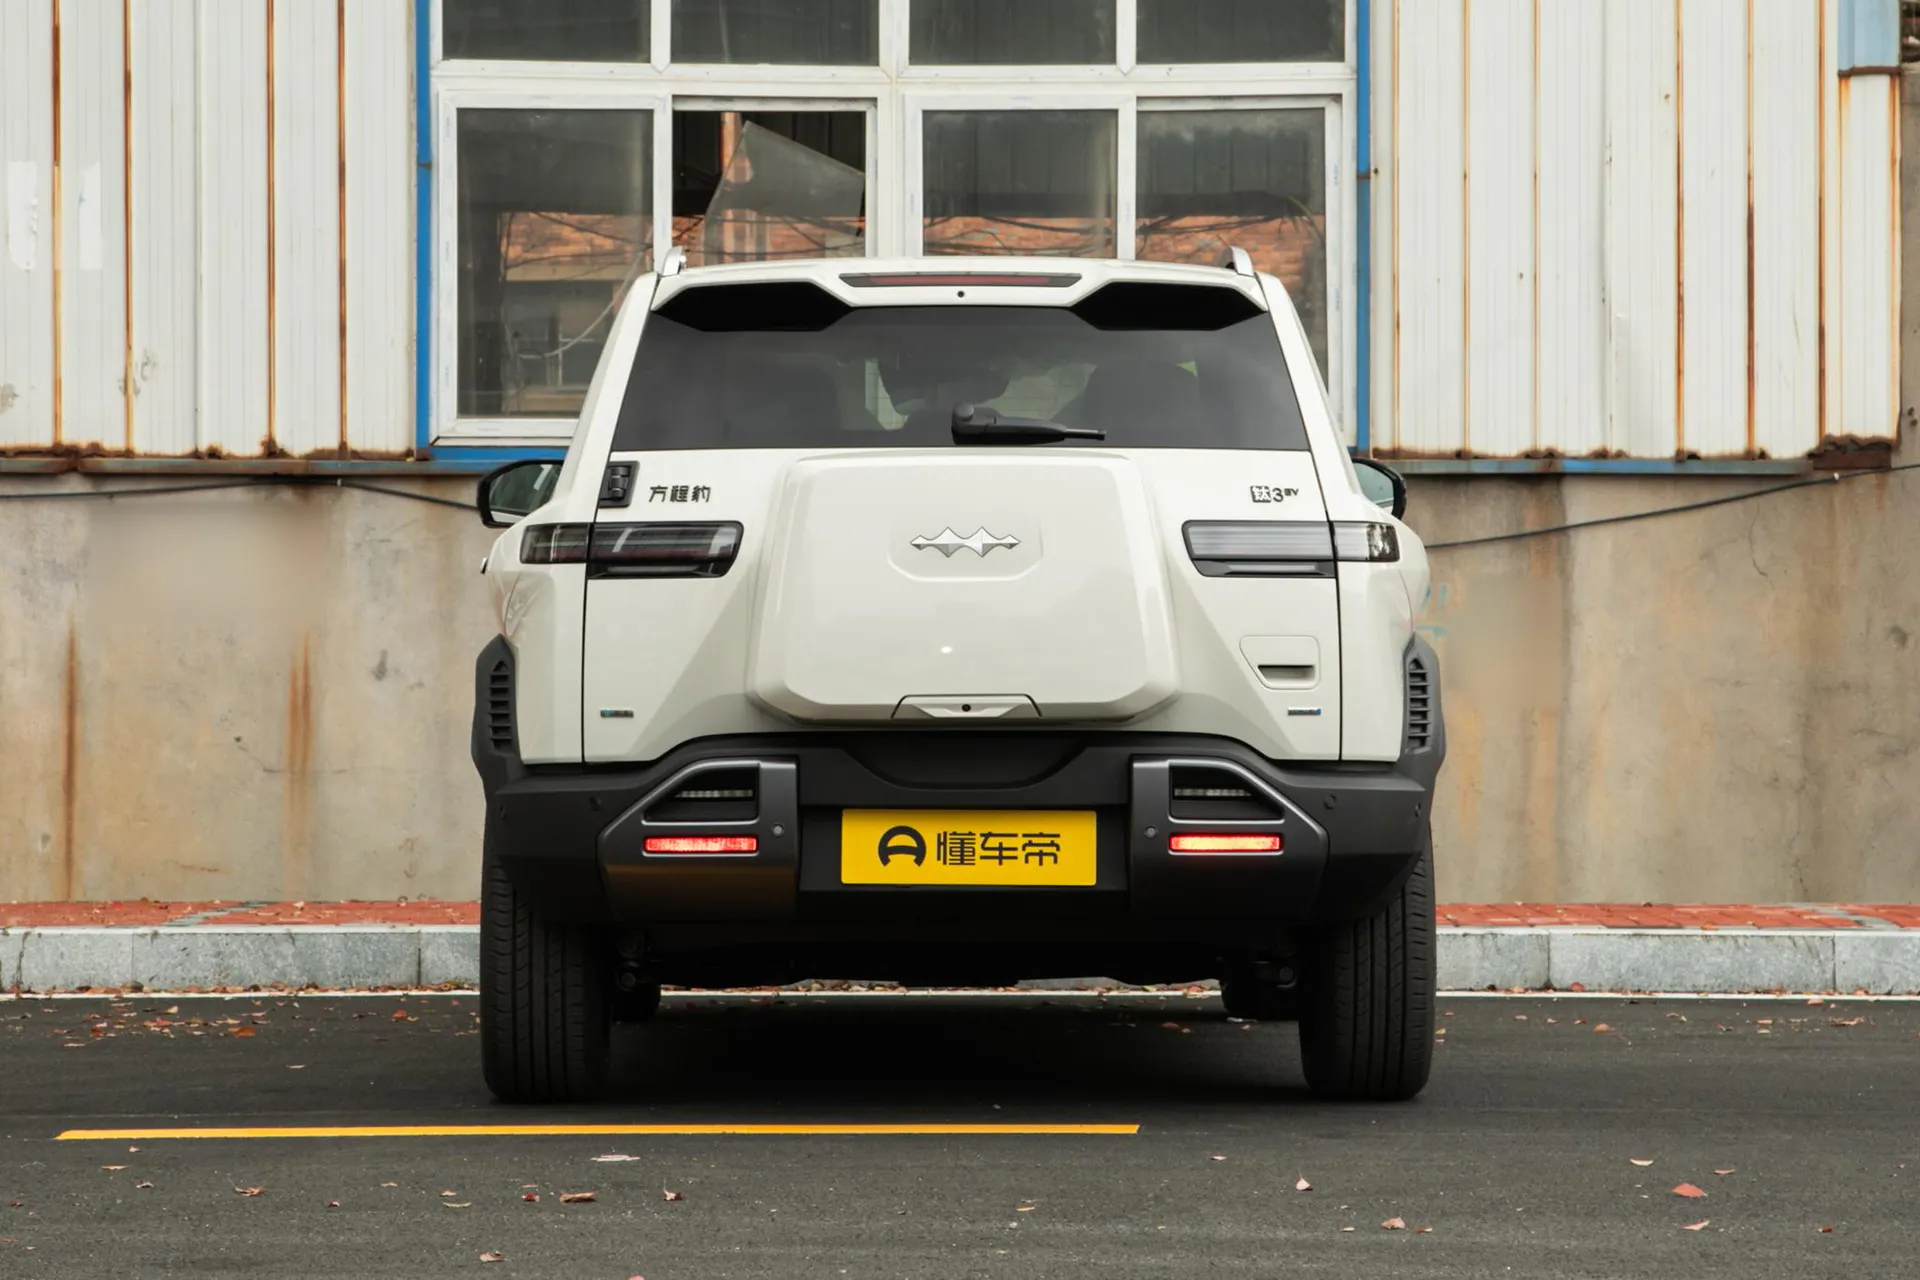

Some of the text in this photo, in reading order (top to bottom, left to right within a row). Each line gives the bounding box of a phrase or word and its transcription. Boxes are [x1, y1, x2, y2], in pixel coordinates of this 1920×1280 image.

[649, 485, 711, 503] 方程豹
[936, 831, 1061, 866] 懂车帝
